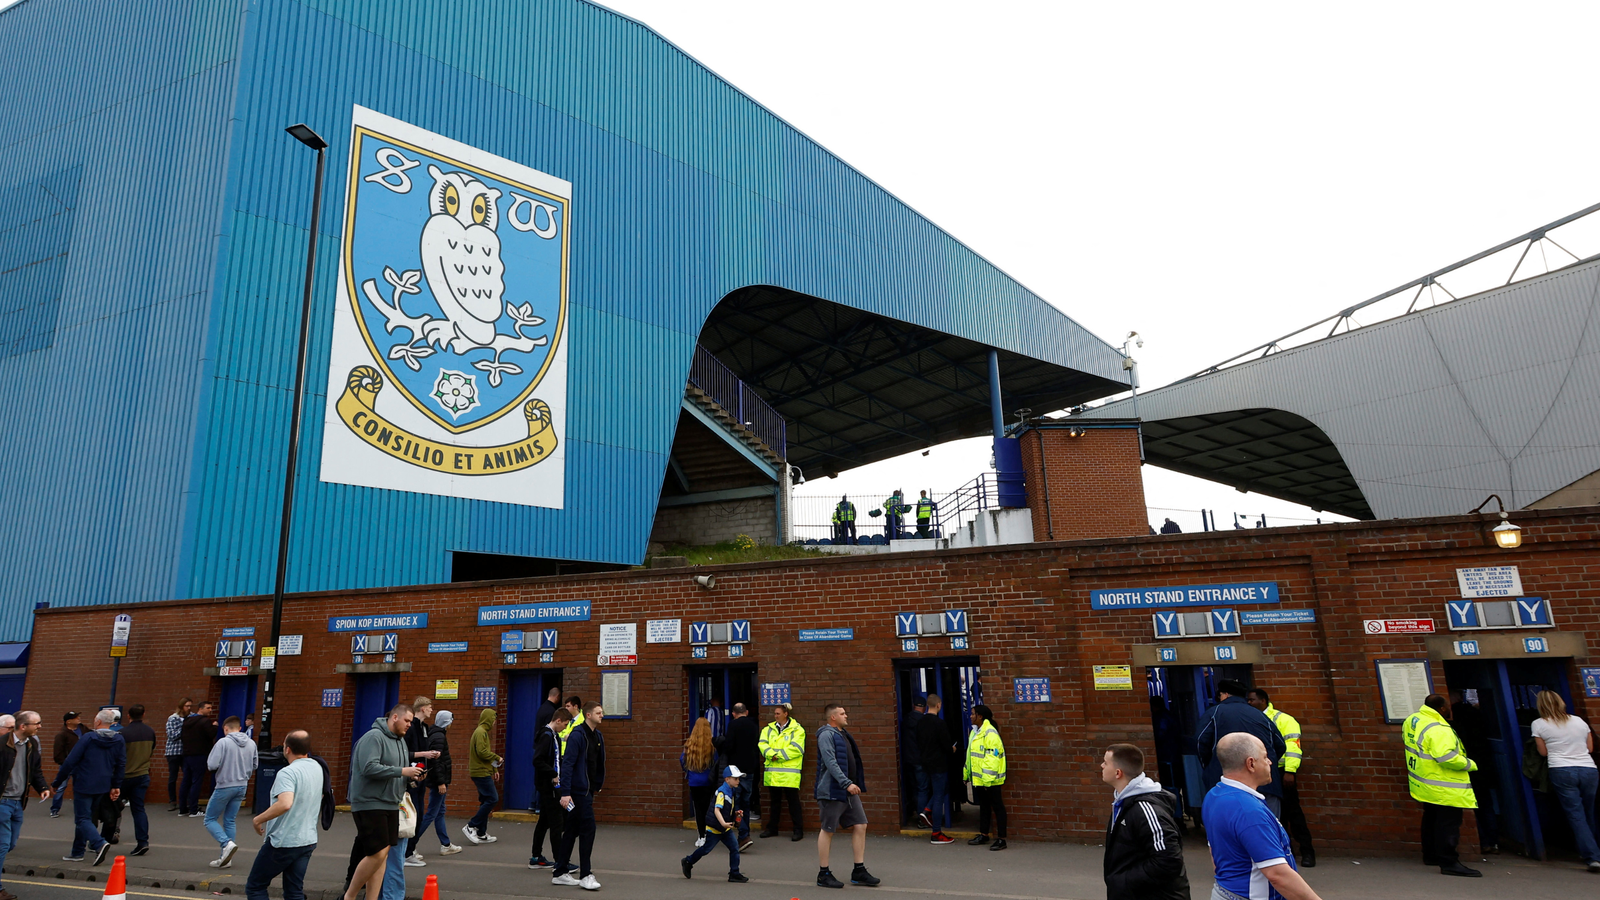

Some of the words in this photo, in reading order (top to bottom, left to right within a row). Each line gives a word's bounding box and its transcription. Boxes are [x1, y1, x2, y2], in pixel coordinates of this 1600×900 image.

[352, 411, 444, 466] CONSILIO
[454, 453, 474, 470] ET
[482, 439, 545, 470] ANIMIS
[1100, 592, 1141, 605] NORTH
[1145, 590, 1184, 603] STAND
[1189, 588, 1256, 602] ENTRANCE
[1260, 587, 1269, 598] Y
[481, 610, 507, 620] NORTH
[510, 609, 535, 619] STAND
[538, 607, 580, 618] ENTRANCE
[582, 606, 589, 616] Y
[1450, 603, 1471, 623] Y
[1519, 600, 1540, 621] Y
[336, 620, 356, 629] SPION
[358, 619, 372, 628] KOP
[374, 617, 410, 627] ENTRANCE
[412, 616, 418, 625] X
[900, 615, 915, 632] Y
[947, 612, 961, 630] Y
[1157, 613, 1175, 632] Y
[1213, 611, 1231, 630] Y
[694, 624, 705, 640] Y
[733, 622, 746, 638] Y
[356, 636, 365, 650] X
[385, 635, 395, 649] X
[544, 631, 554, 646] Y
[906, 640, 915, 650] 85
[955, 638, 964, 648] 86
[1528, 640, 1542, 650] 90
[219, 642, 228, 654] X
[245, 641, 254, 654] X
[1220, 648, 1231, 658] 88
[1462, 643, 1474, 653] 89
[1163, 650, 1173, 660] 87
[1409, 756, 1416, 770] 41
